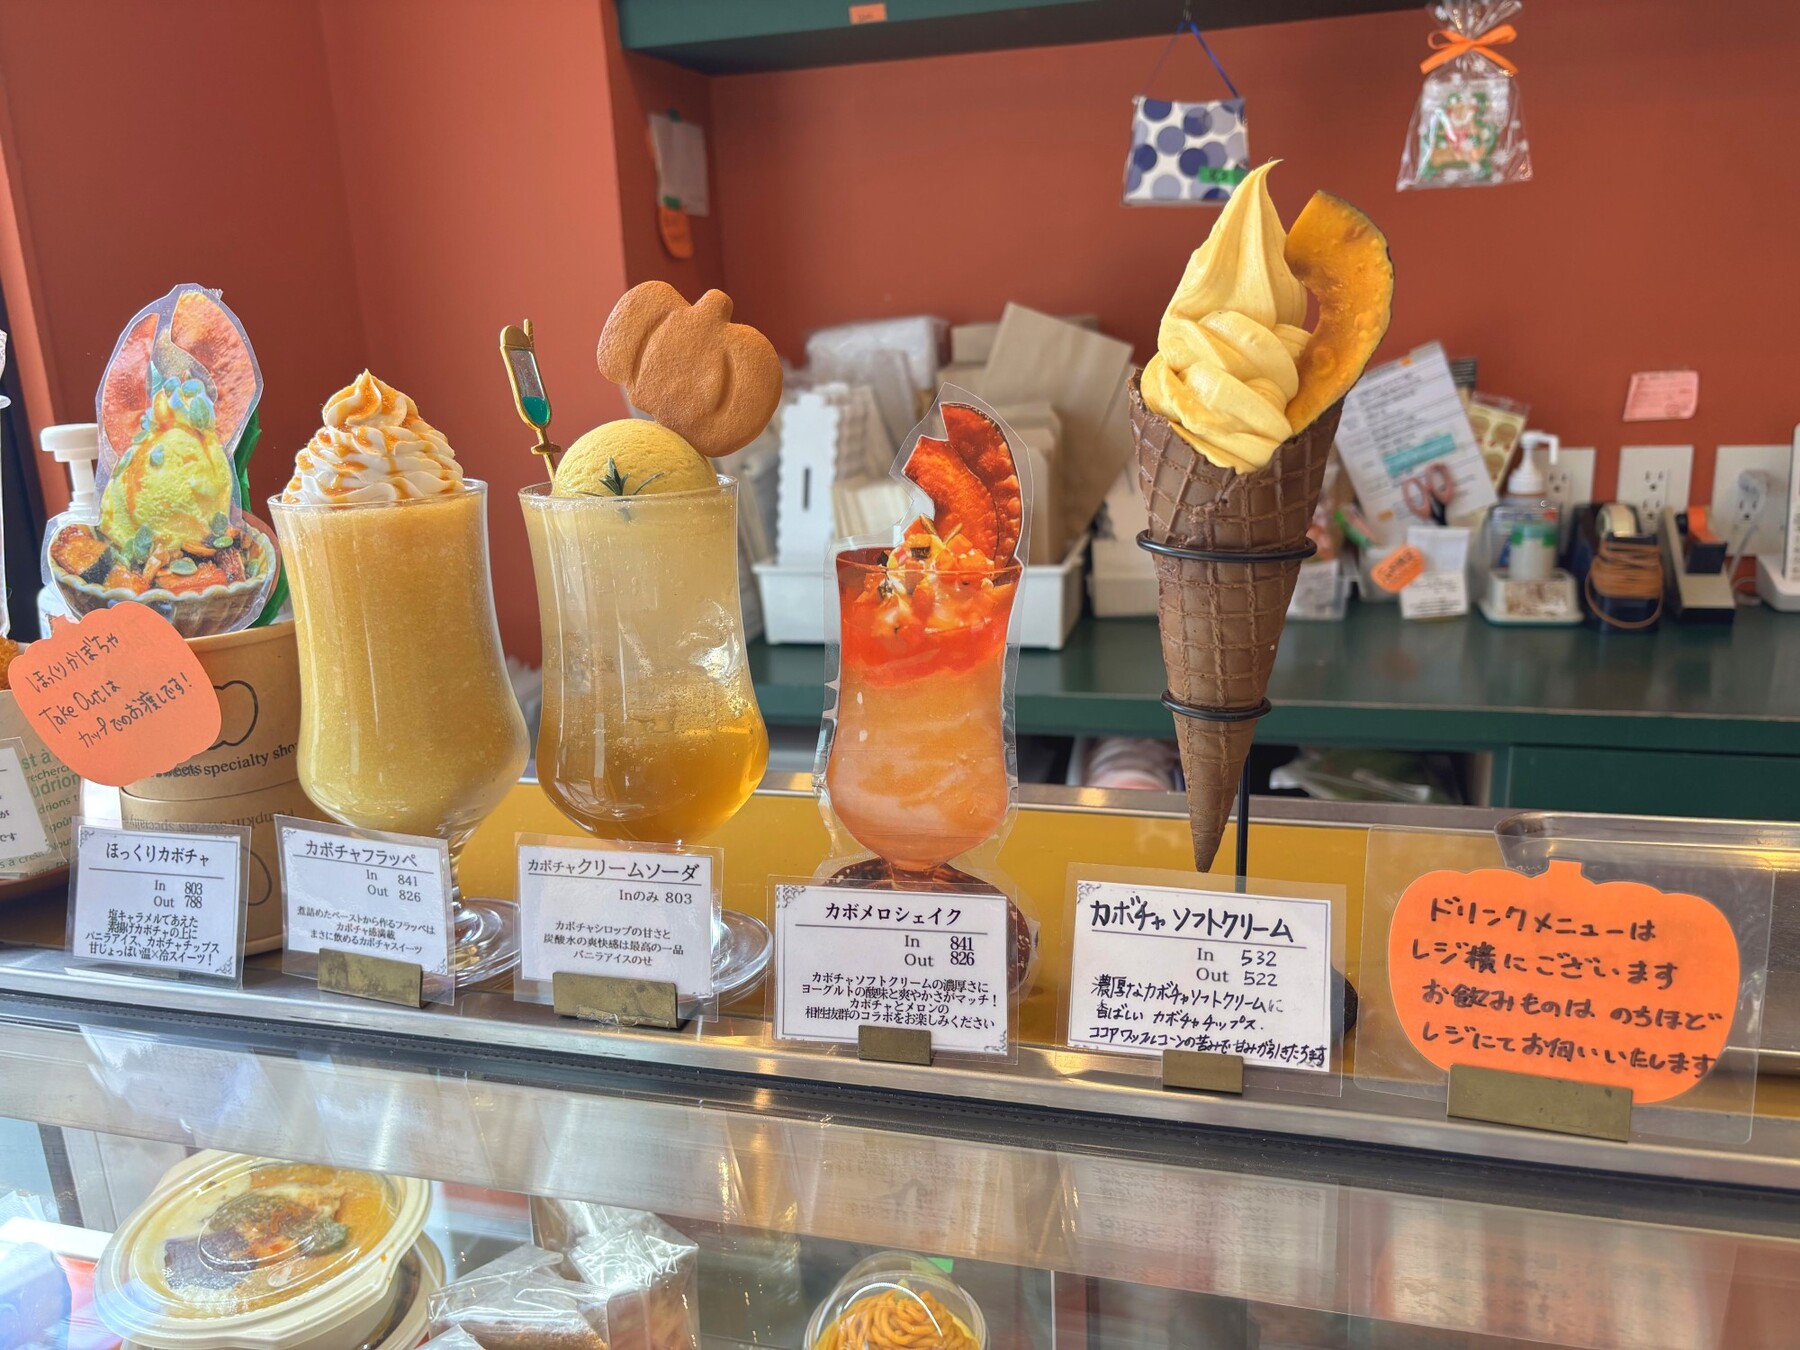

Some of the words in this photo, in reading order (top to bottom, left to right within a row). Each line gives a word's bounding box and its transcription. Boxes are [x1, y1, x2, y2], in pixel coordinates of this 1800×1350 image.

[25, 632, 120, 694] ほっくりかぼちゃ
[38, 704, 78, 734] Take
[204, 752, 269, 777] specialty
[273, 741, 298, 760] sho
[106, 842, 209, 867] ほっくりカボチャ
[306, 839, 418, 867] カボチャフラッペ
[366, 869, 378, 881] In
[397, 874, 418, 887] 841
[528, 858, 700, 882] カボチャクリームソーダ
[154, 880, 166, 891] In
[184, 882, 203, 895] 803
[367, 884, 389, 898] Out
[398, 889, 421, 903] 826
[665, 892, 692, 905] 803
[153, 895, 174, 908] Out
[184, 894, 203, 909] 788
[826, 902, 962, 926] カボメロシェイク
[1430, 896, 1657, 940] ドリンクメニューは
[555, 920, 672, 940] カボチャシロップの甘さと
[543, 933, 684, 955] 炭酸水の爽快感は最高の一品
[904, 935, 920, 948] In
[950, 936, 973, 951] 841
[573, 950, 653, 967] バニラアイスのせ
[904, 953, 934, 967] Out
[950, 951, 975, 966] 826
[1197, 948, 1214, 962] In
[1240, 950, 1277, 967] 532
[1412, 938, 1679, 990] レジ横にございます
[812, 971, 989, 994] カボチャソフトクリームの濃厚さに
[1196, 967, 1229, 983] Out
[1243, 971, 1278, 987] 522
[850, 998, 949, 1015] カボチャとメロンの
[805, 1006, 995, 1030] 相性抜群のコラボをお楽しみください
[1422, 1021, 1716, 1078] レジにてお伺いいたします
